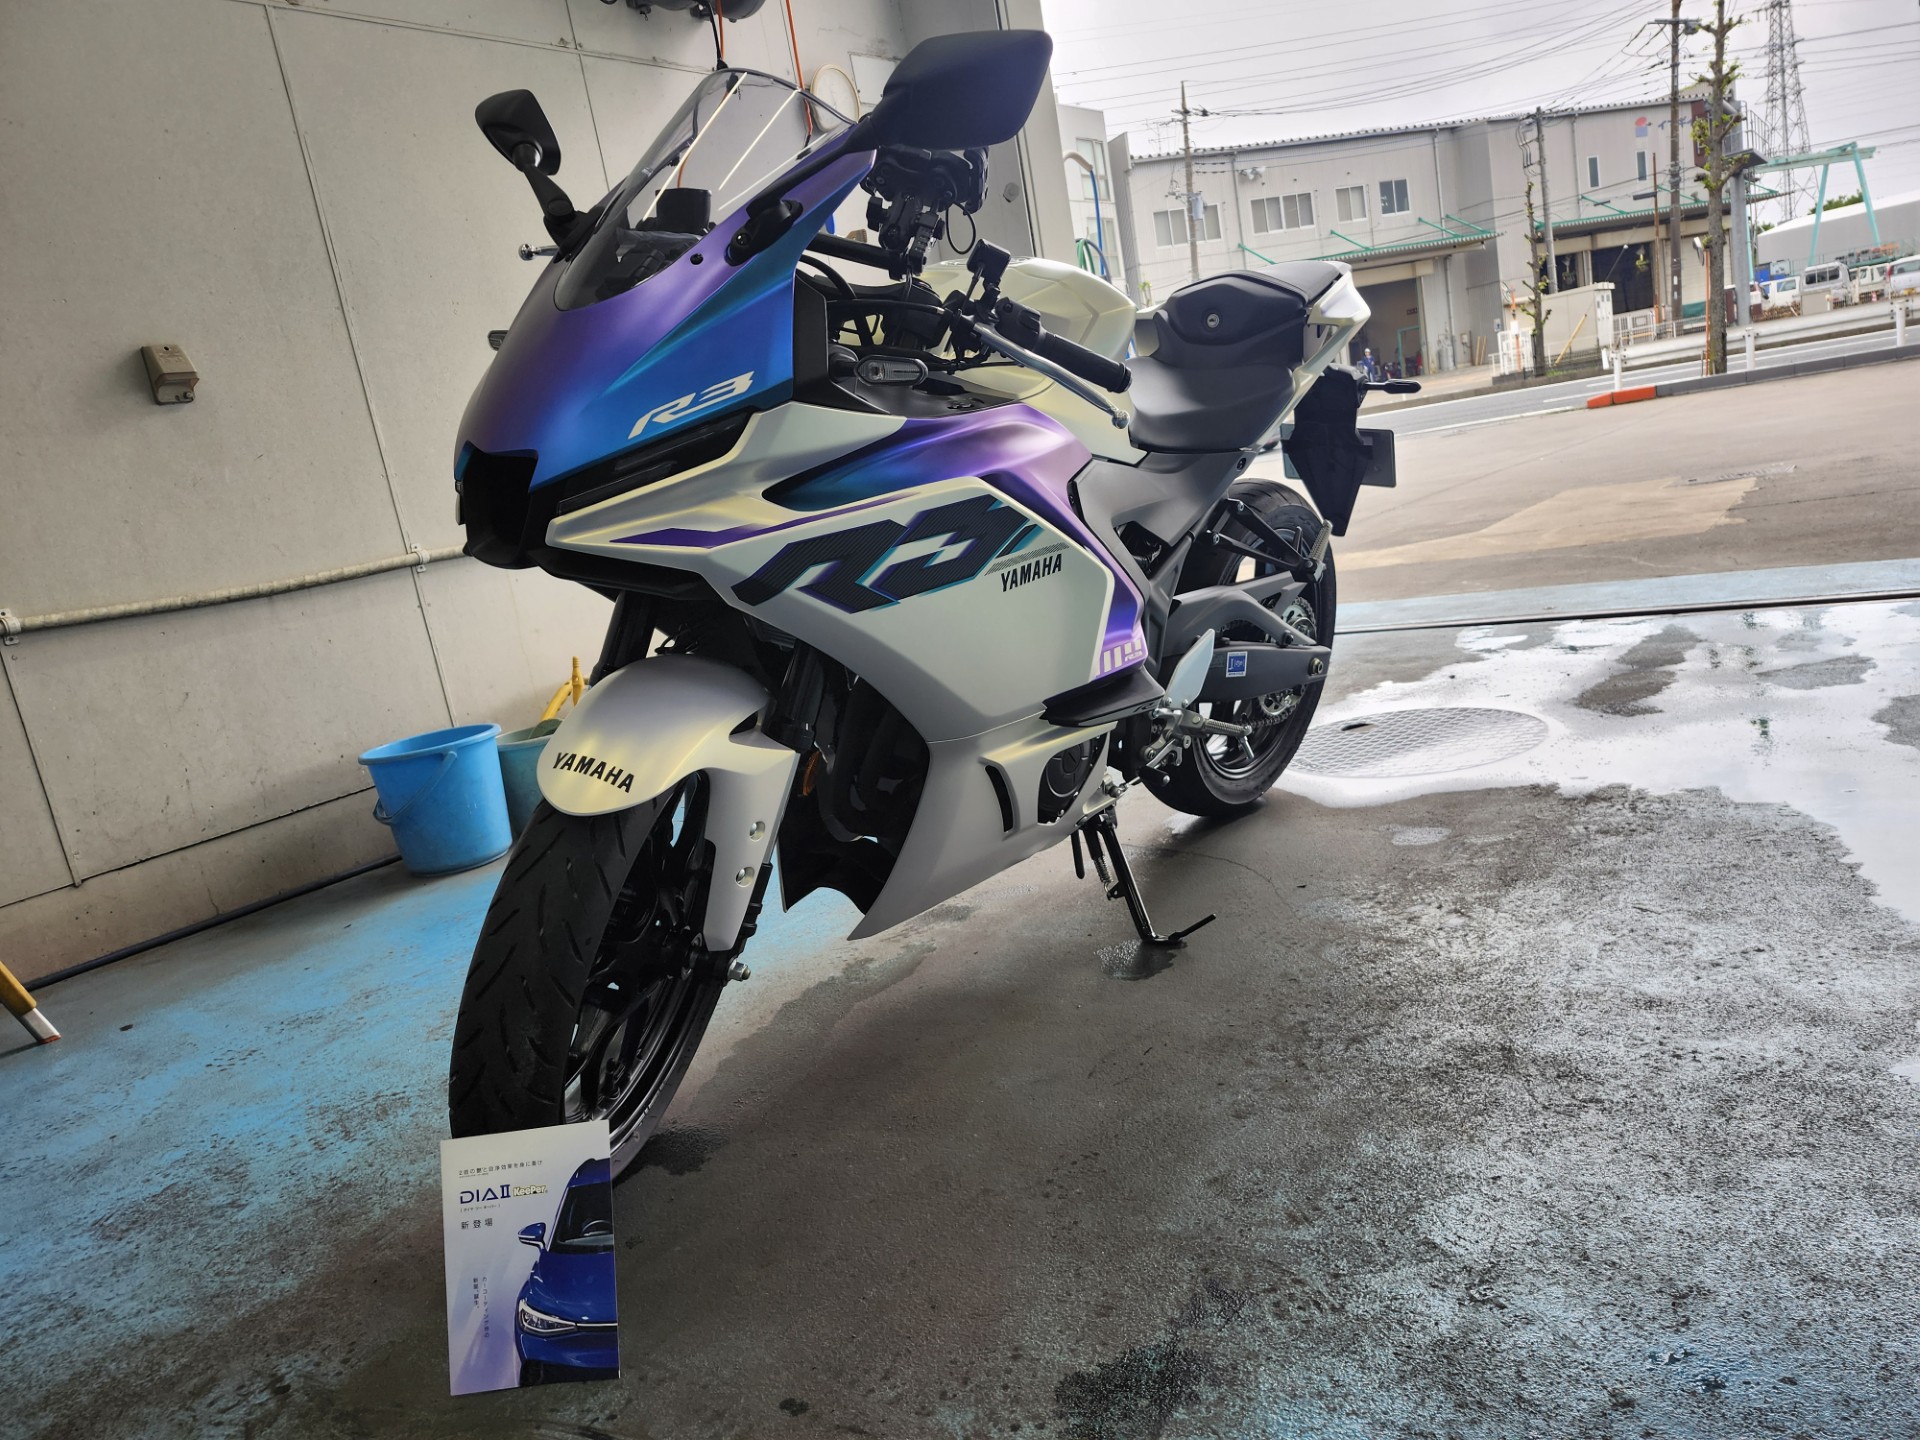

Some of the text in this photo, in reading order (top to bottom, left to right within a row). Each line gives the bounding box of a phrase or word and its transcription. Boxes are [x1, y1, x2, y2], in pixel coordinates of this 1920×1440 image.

[628, 371, 754, 440] R3
[731, 493, 1032, 614] R3
[1001, 554, 1062, 592] YAMAHA
[553, 751, 635, 793] YAMAHA
[461, 1218, 493, 1230] 新登場
